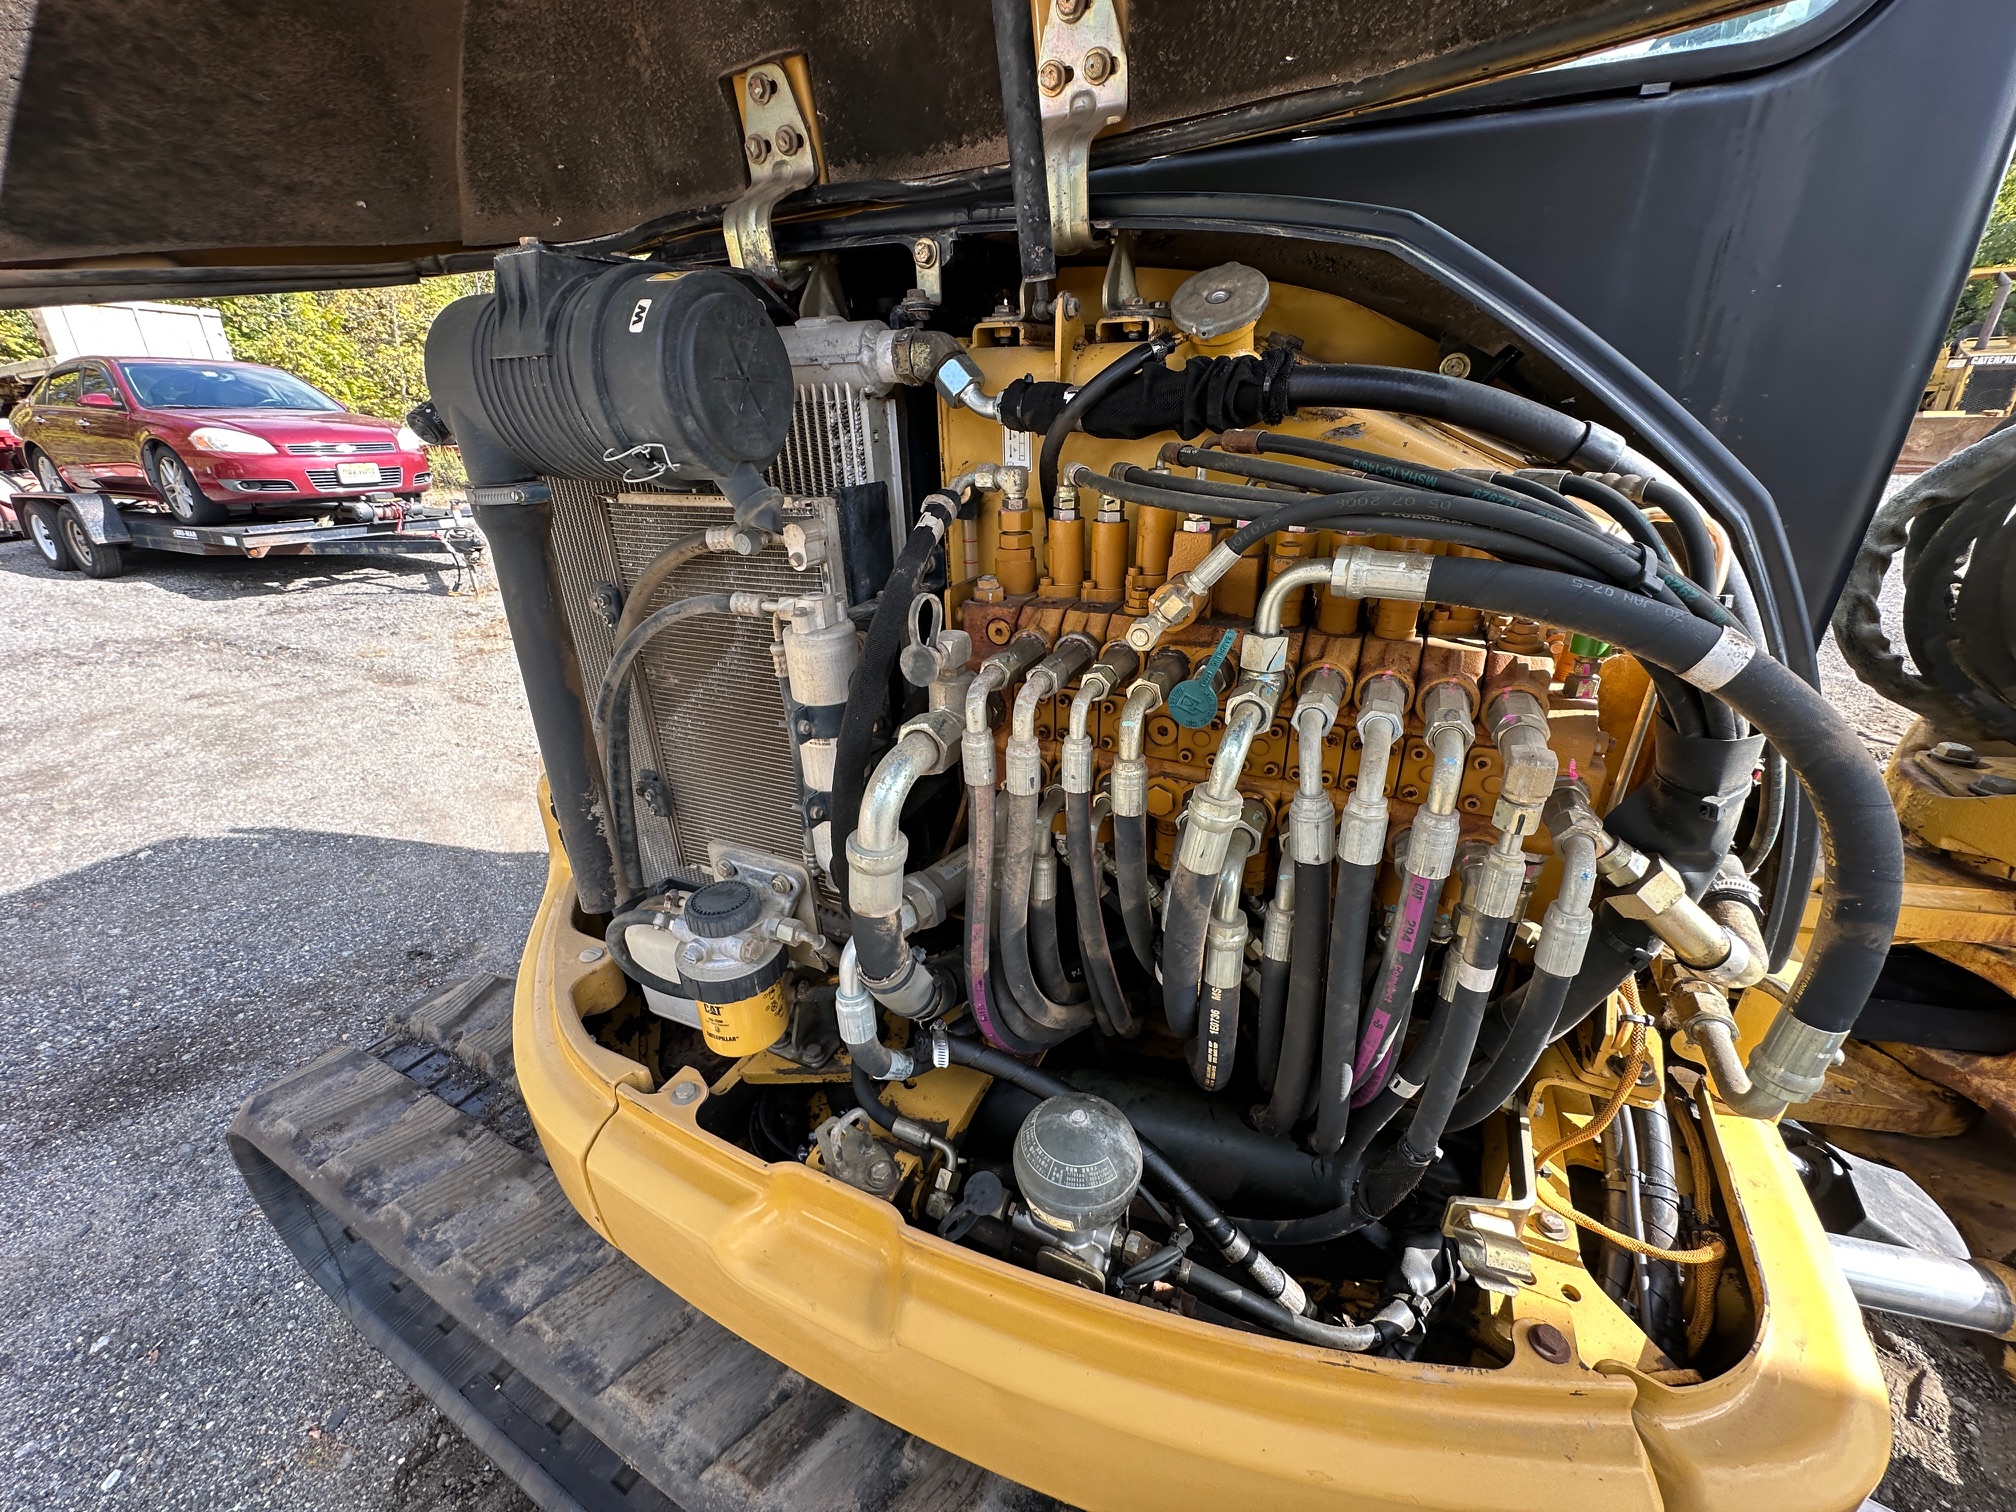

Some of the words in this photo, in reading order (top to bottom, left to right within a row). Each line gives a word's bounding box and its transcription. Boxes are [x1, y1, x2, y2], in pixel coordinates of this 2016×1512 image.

[1401, 469, 1438, 487] MSHA
[1392, 497, 1416, 507] 07
[1572, 578, 1615, 597] 07-5
[1623, 592, 1654, 608] JAN
[1412, 882, 1425, 901] CAT
[1401, 919, 1416, 943] 294
[1384, 964, 1403, 1003] Compact
[1211, 986, 1222, 1001] MS
[703, 1003, 722, 1016] CAT
[1209, 1008, 1221, 1035] 1E0736
